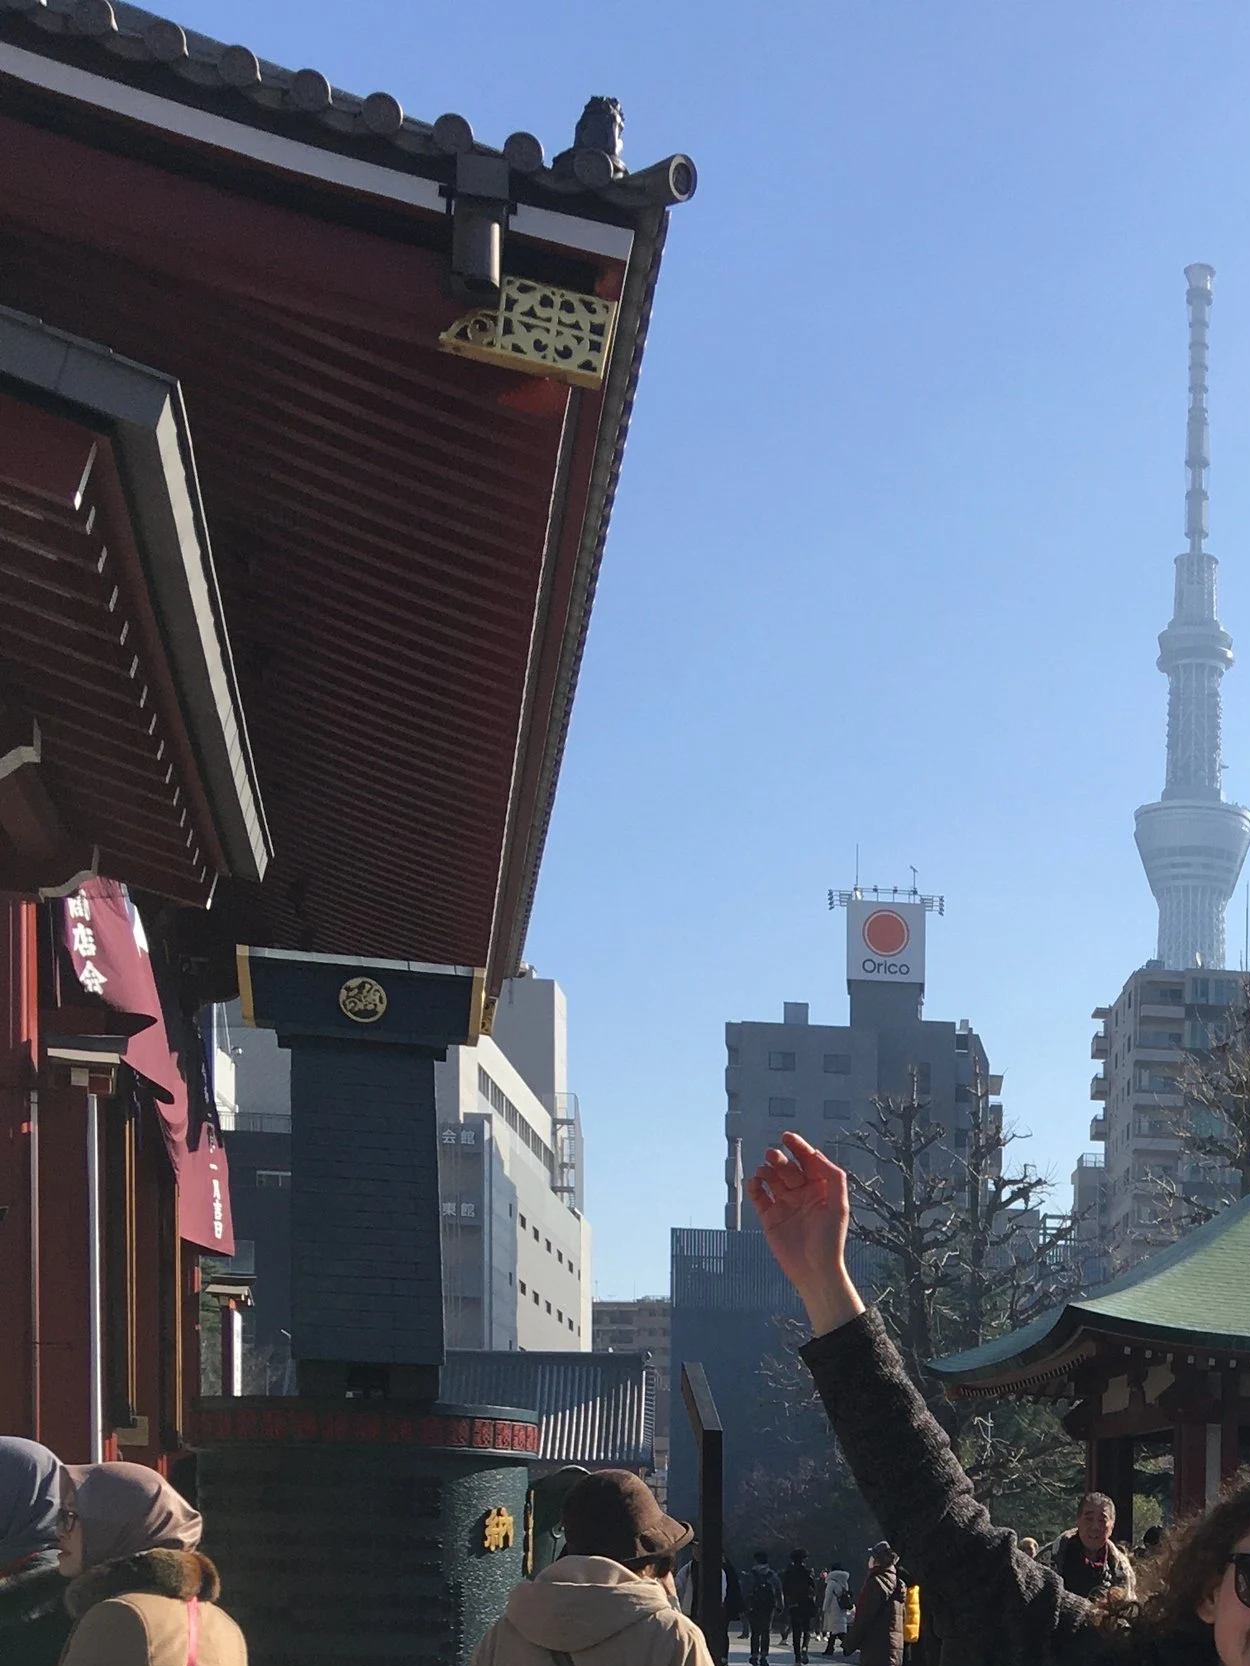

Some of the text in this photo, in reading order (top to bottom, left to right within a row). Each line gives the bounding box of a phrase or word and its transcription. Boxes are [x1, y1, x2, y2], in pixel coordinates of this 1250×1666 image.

[862, 958, 910, 975] Orico
[441, 1128, 475, 1145] 会館
[442, 1202, 475, 1217] 東館
[484, 1506, 514, 1552] 納
